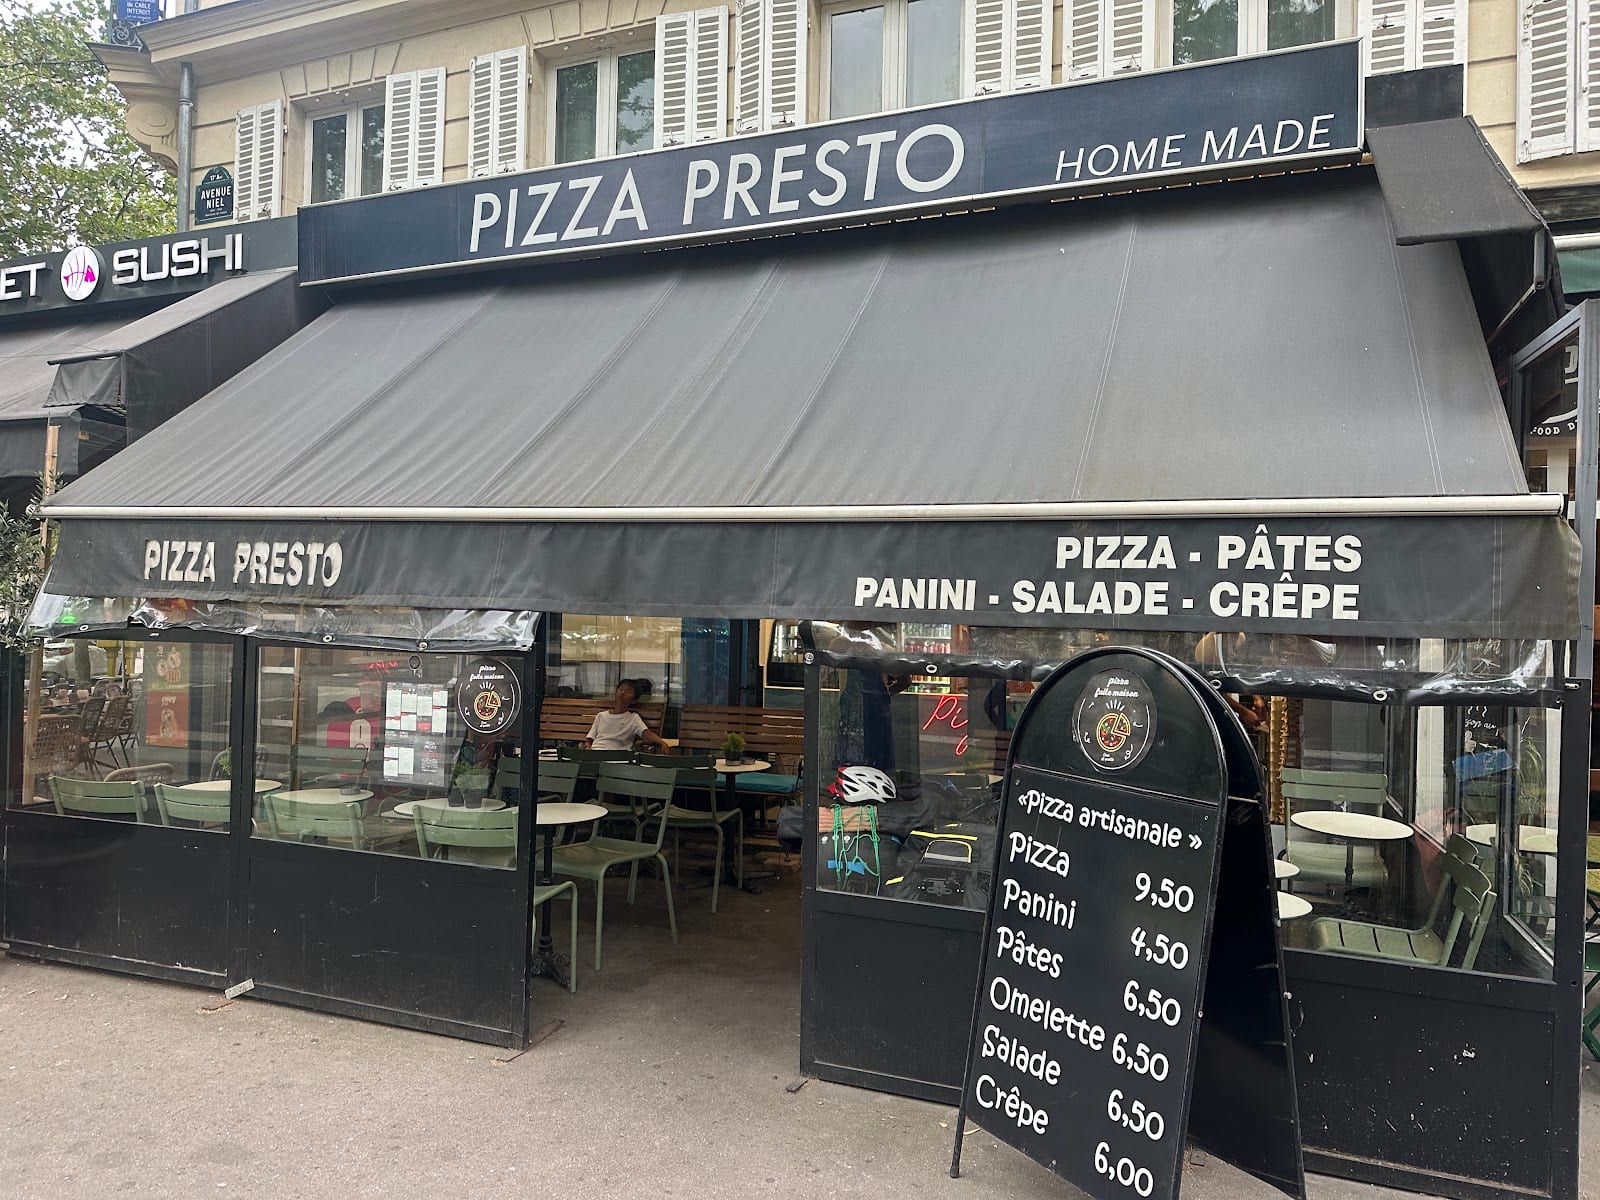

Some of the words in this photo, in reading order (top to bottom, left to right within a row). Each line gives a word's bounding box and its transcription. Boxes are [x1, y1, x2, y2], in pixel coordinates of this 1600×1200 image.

[1055, 134, 1186, 181] HOME
[1200, 113, 1335, 163] MADE
[201, 186, 232, 200] AVENUE
[206, 198, 225, 209] NIEL
[470, 168, 648, 252] PIZZA
[683, 124, 965, 225] PRESTO
[0, 262, 46, 300] ET
[112, 233, 243, 285] SUSHI
[144, 539, 216, 582] PIZZA
[232, 541, 342, 587] PRESTO
[1056, 535, 1176, 569] PIZZA
[1217, 524, 1362, 572] PÂTES
[854, 577, 976, 611] PANINI
[1012, 579, 1169, 615] SALADE
[1209, 571, 1360, 620] CRÊPE
[1079, 806, 1182, 847] artisanale
[1009, 831, 1070, 877] Pizza
[1134, 872, 1195, 912] 9,50
[1003, 878, 1076, 929] Panini
[1130, 926, 1189, 969] 4,50
[996, 926, 1064, 978] Pâtes
[1123, 980, 1181, 1026] 6,50
[990, 977, 1105, 1050] Omelette
[1112, 1033, 1169, 1081] 6,50
[981, 1024, 1061, 1085] Salade
[1107, 1089, 1165, 1140] 6,50
[976, 1074, 1049, 1134] Crêpe
[1094, 1141, 1154, 1197] 6,00
